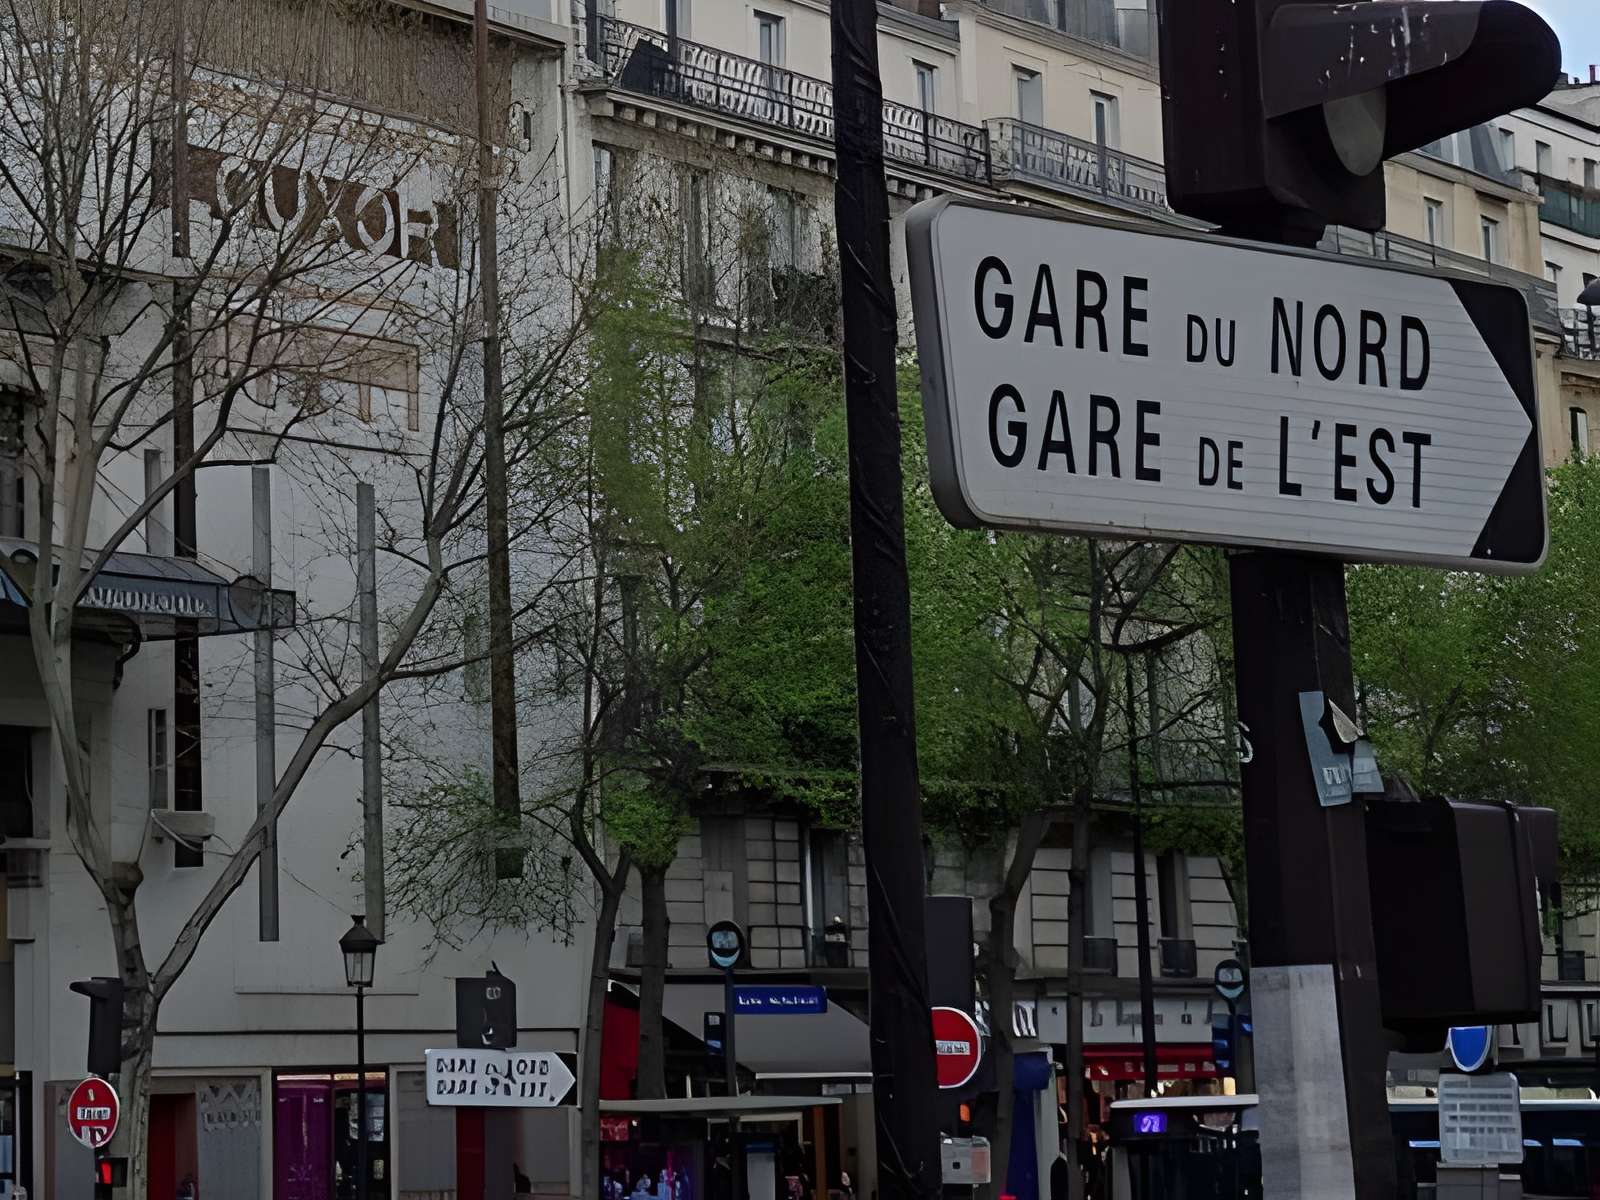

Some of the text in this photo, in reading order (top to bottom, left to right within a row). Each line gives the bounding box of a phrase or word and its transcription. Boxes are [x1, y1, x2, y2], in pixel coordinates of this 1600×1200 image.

[974, 255, 1431, 391] GARE DU NORD
[988, 383, 1432, 508] GARE DE L'EST
